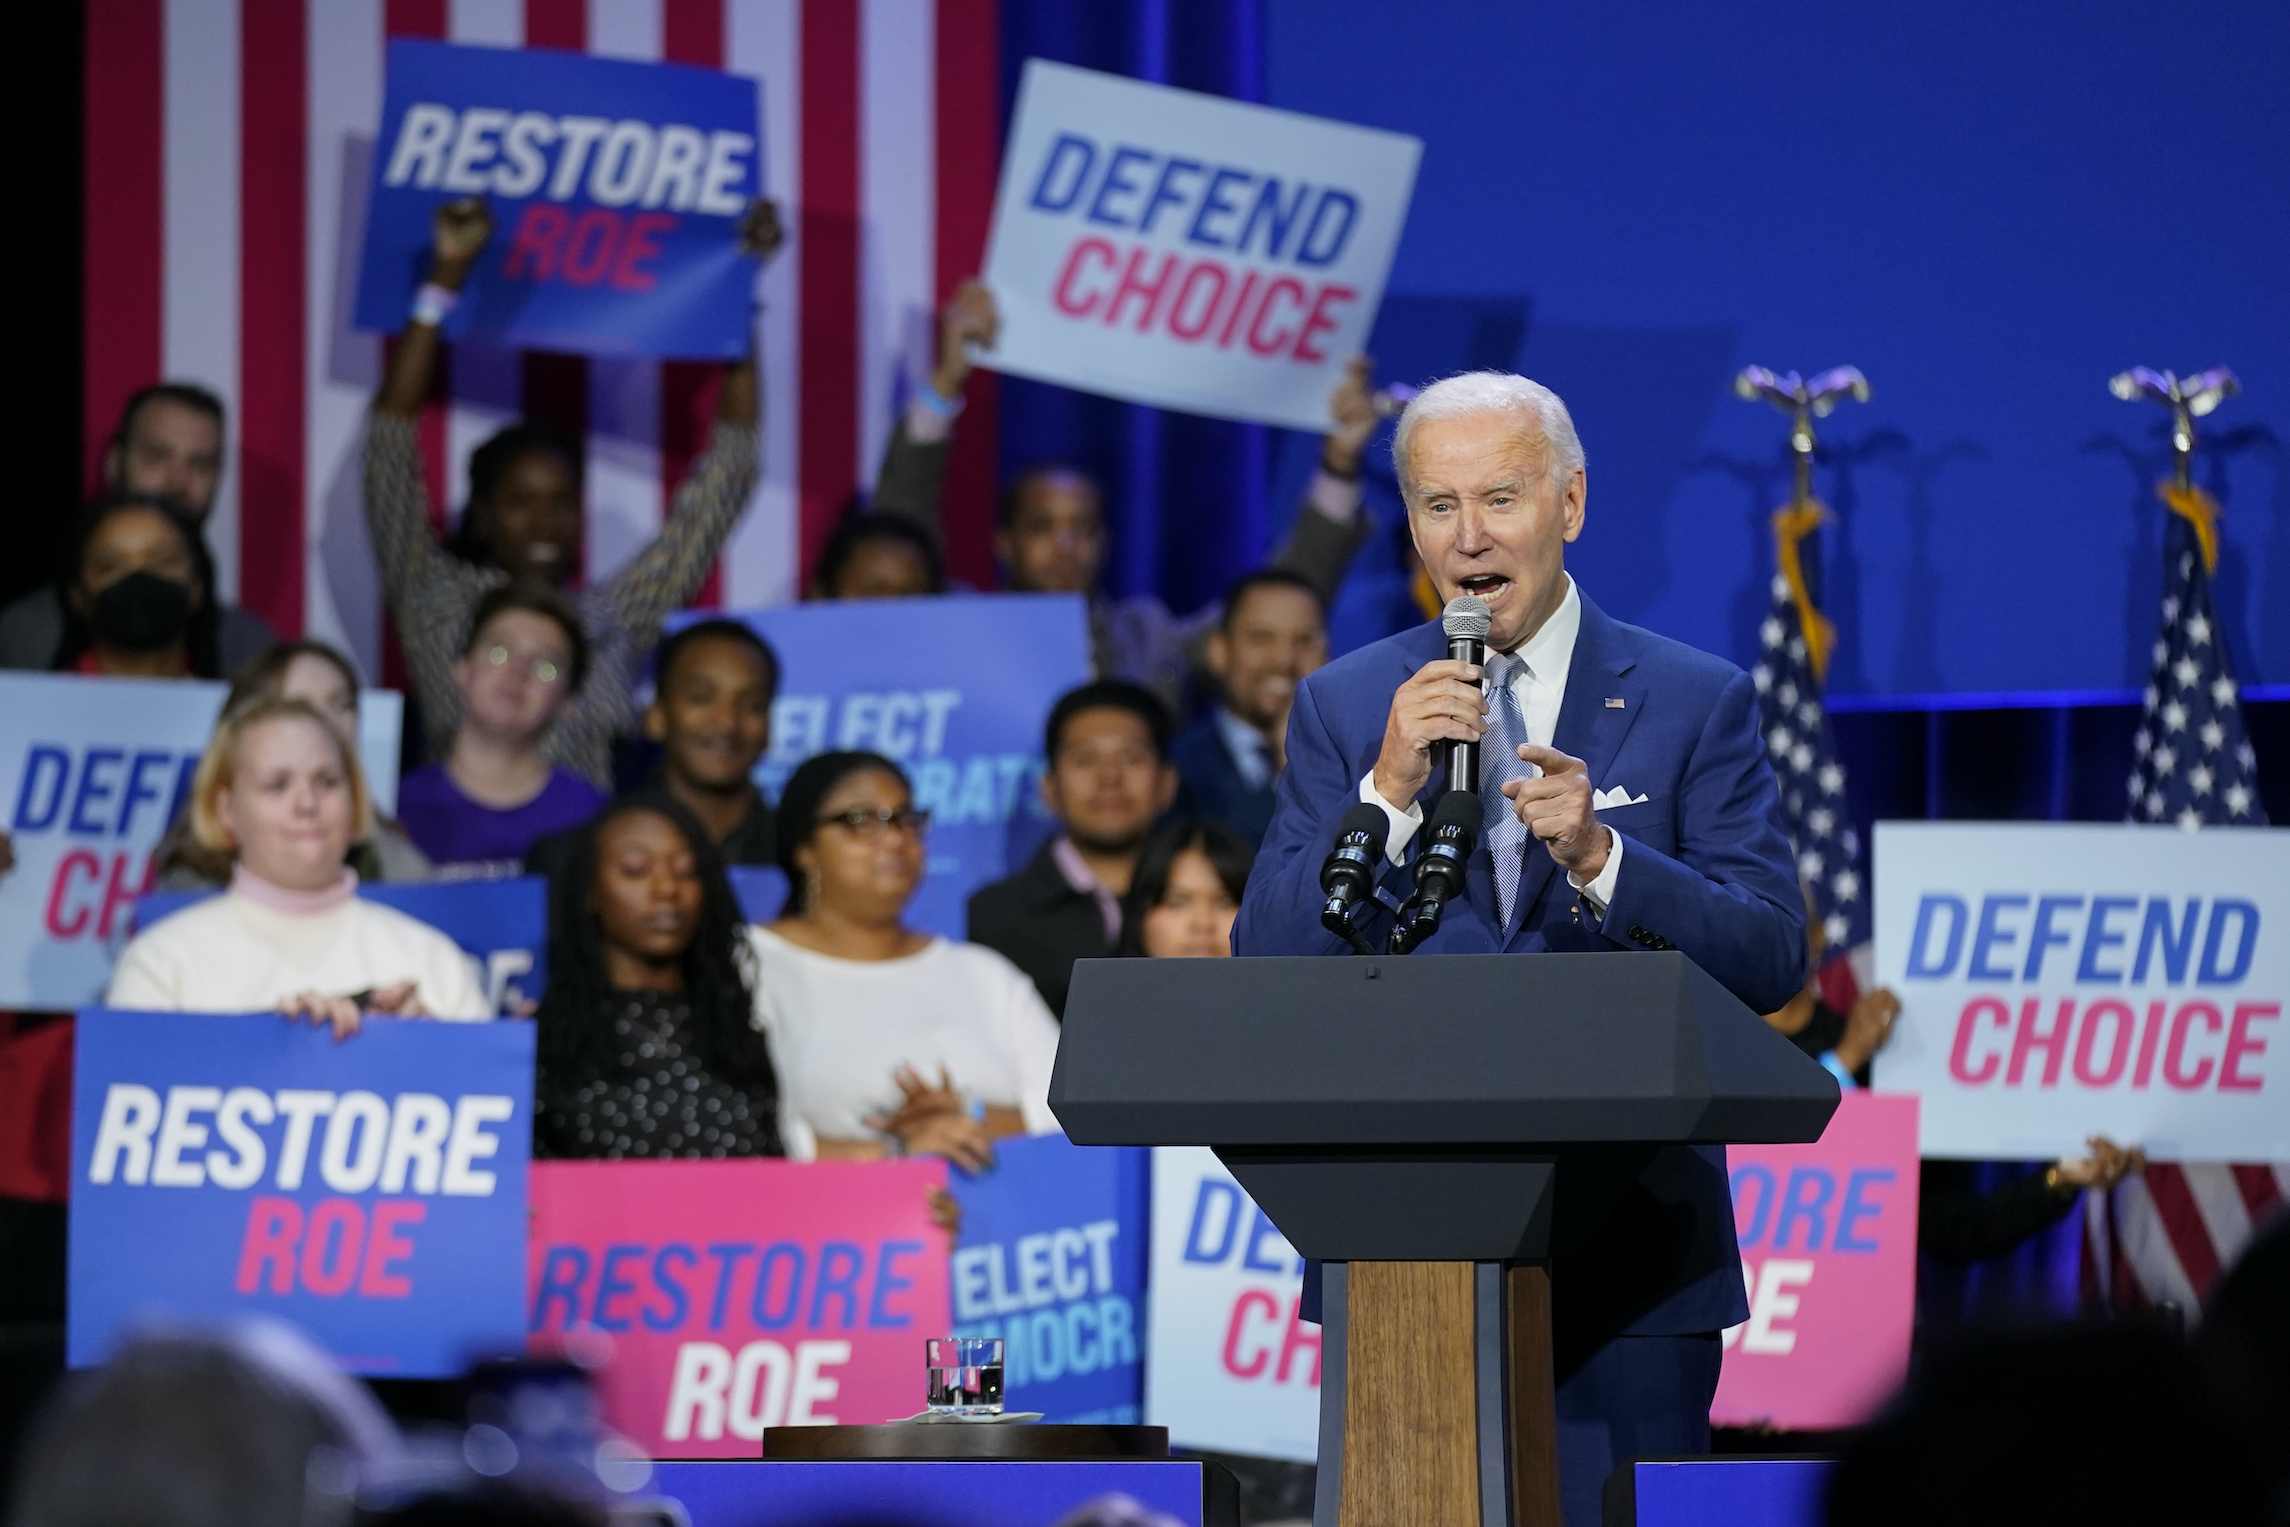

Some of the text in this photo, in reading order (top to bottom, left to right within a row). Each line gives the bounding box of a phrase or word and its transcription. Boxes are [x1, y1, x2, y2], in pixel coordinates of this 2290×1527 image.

[385, 104, 753, 216] RESTORE
[1028, 132, 1362, 270] DEFEND
[505, 204, 679, 292] ROE
[1051, 235, 1358, 365] CHOICE
[1904, 892, 2261, 988] DEFEND
[1947, 996, 2282, 1093] CHOICE
[88, 1082, 515, 1197] RESTORE
[234, 1196, 428, 1298] ROE
[952, 1219, 1119, 1321] ELECT
[1183, 1176, 1305, 1276] DE
[530, 1239, 925, 1334] RESTORE
[663, 1339, 852, 1442] ROE
